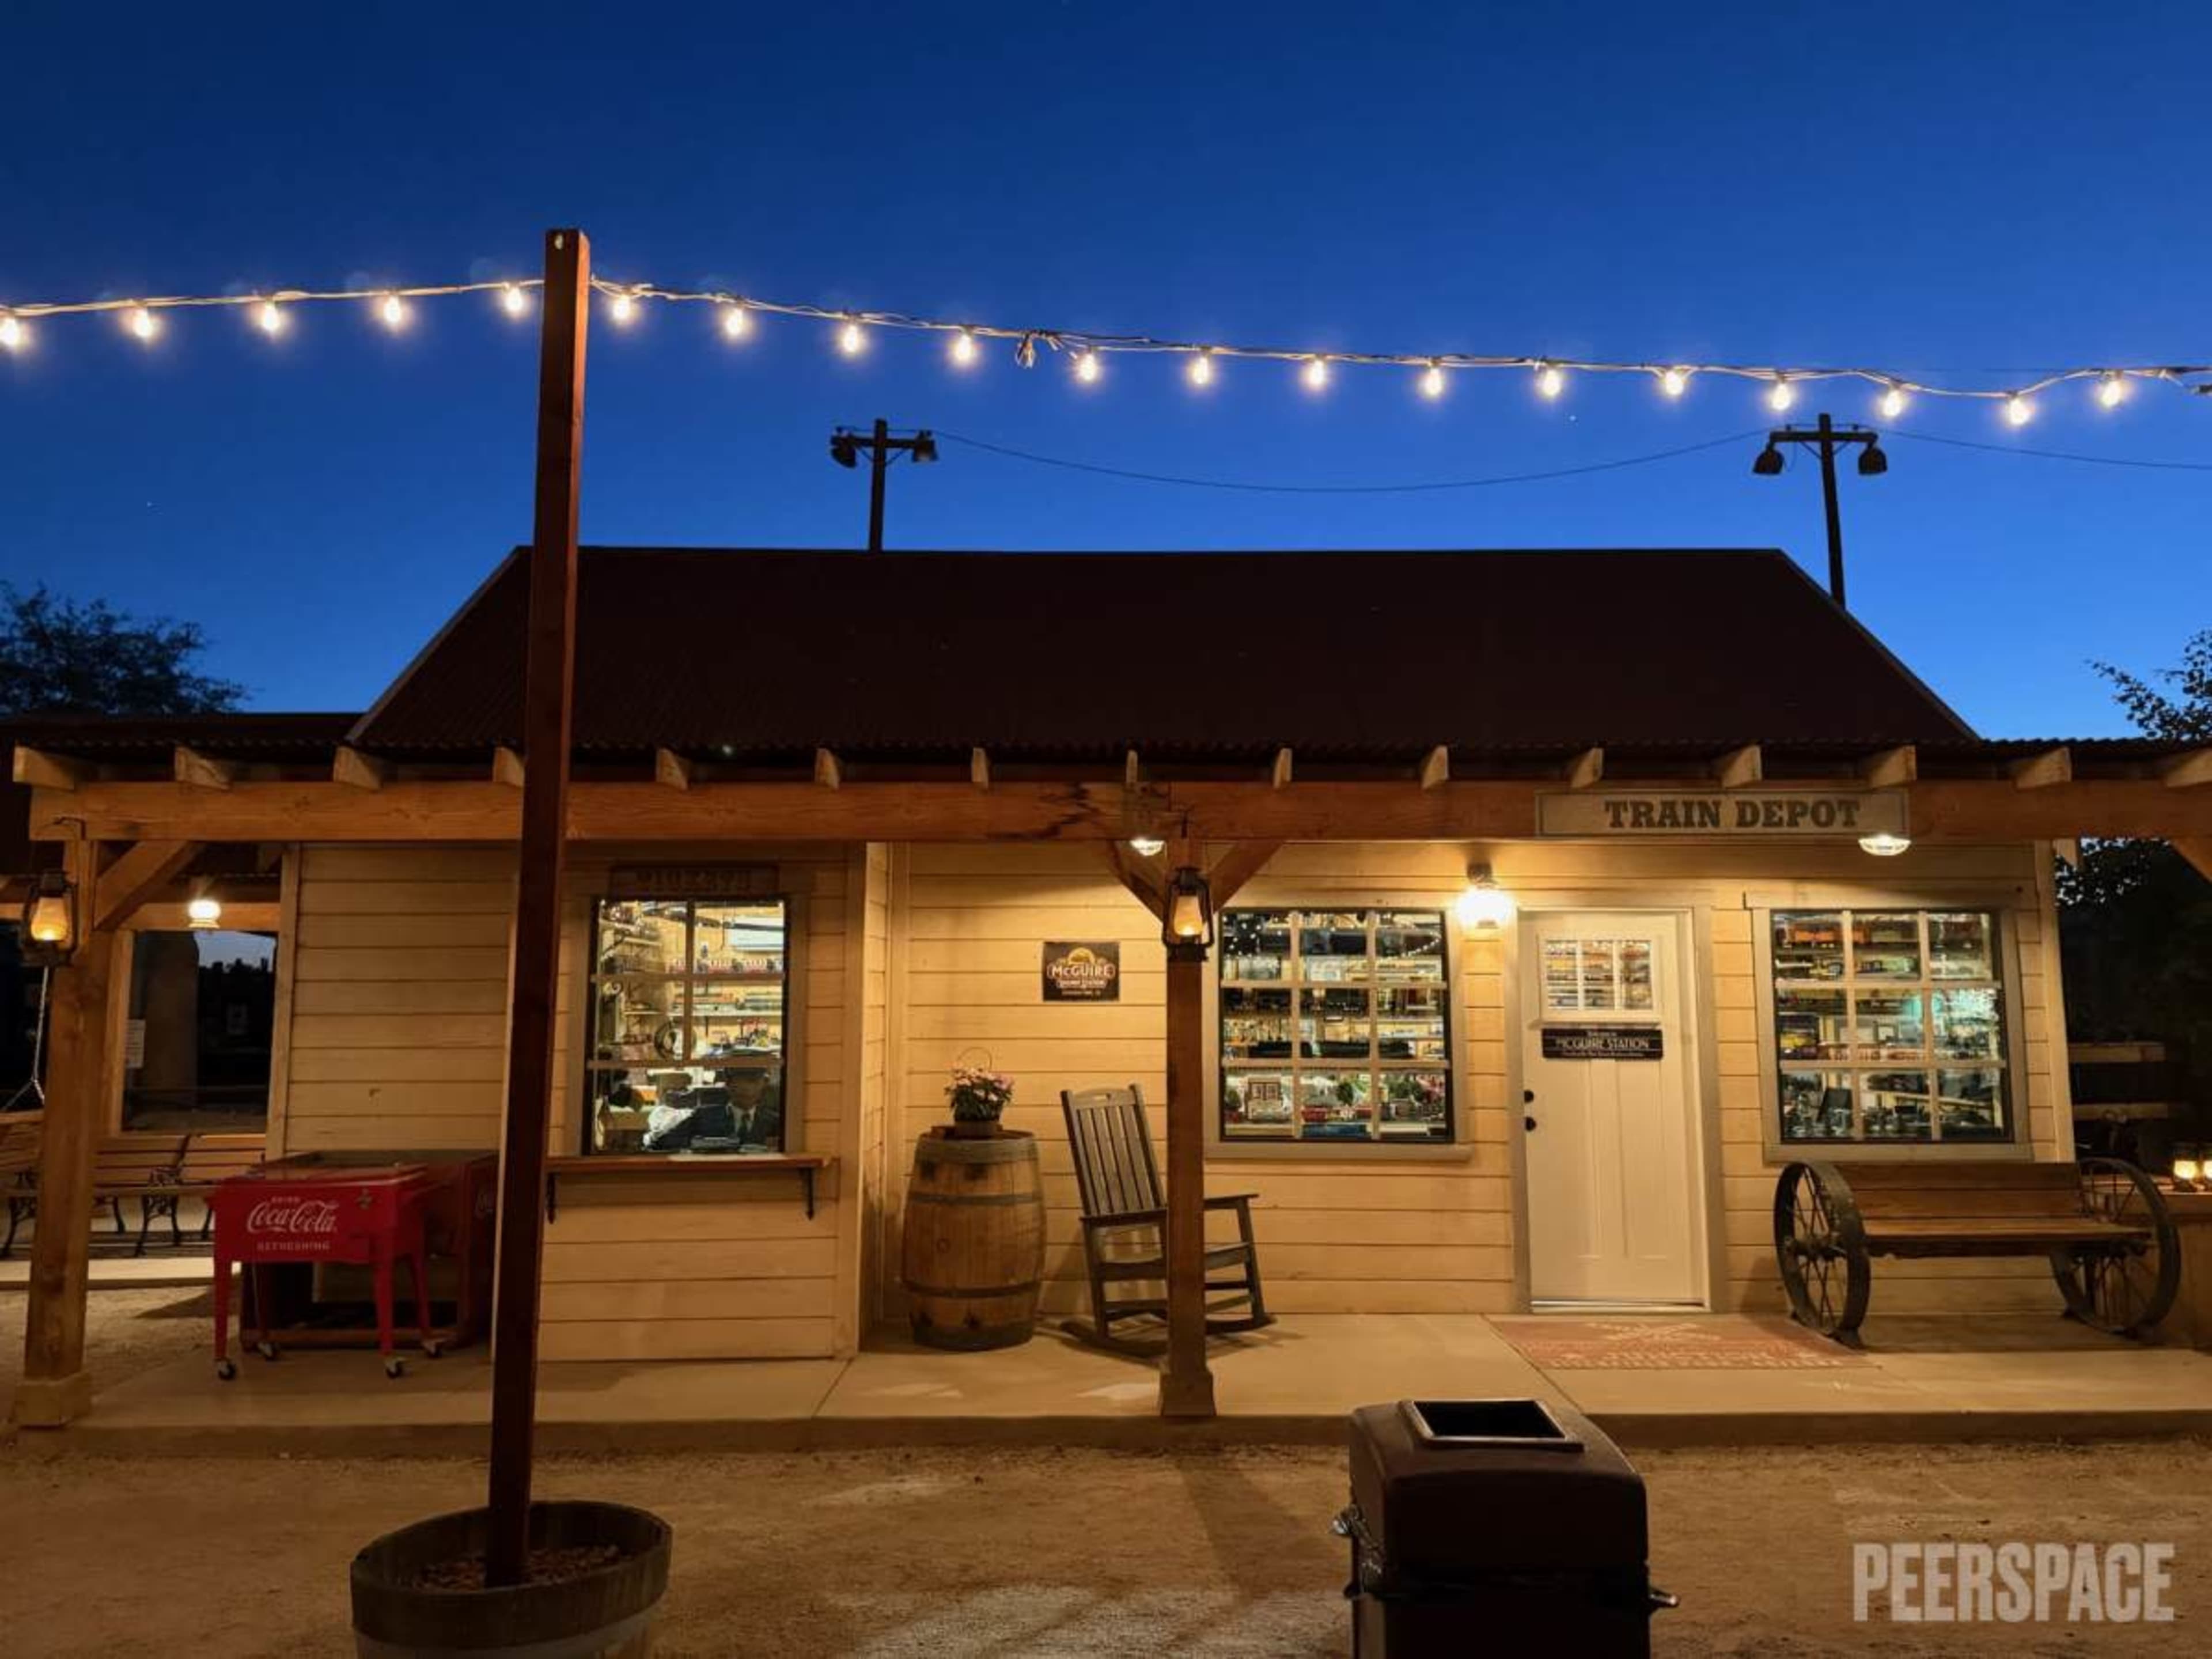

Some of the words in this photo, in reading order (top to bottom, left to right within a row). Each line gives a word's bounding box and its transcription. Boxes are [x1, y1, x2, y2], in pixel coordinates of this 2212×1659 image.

[1604, 800, 1721, 828] TRAIN
[1736, 800, 1860, 828] DEPOT
[1052, 964, 1109, 977] McGUIRE
[1609, 1037, 1649, 1050] STATION
[247, 1200, 339, 1234] Coca-Cola
